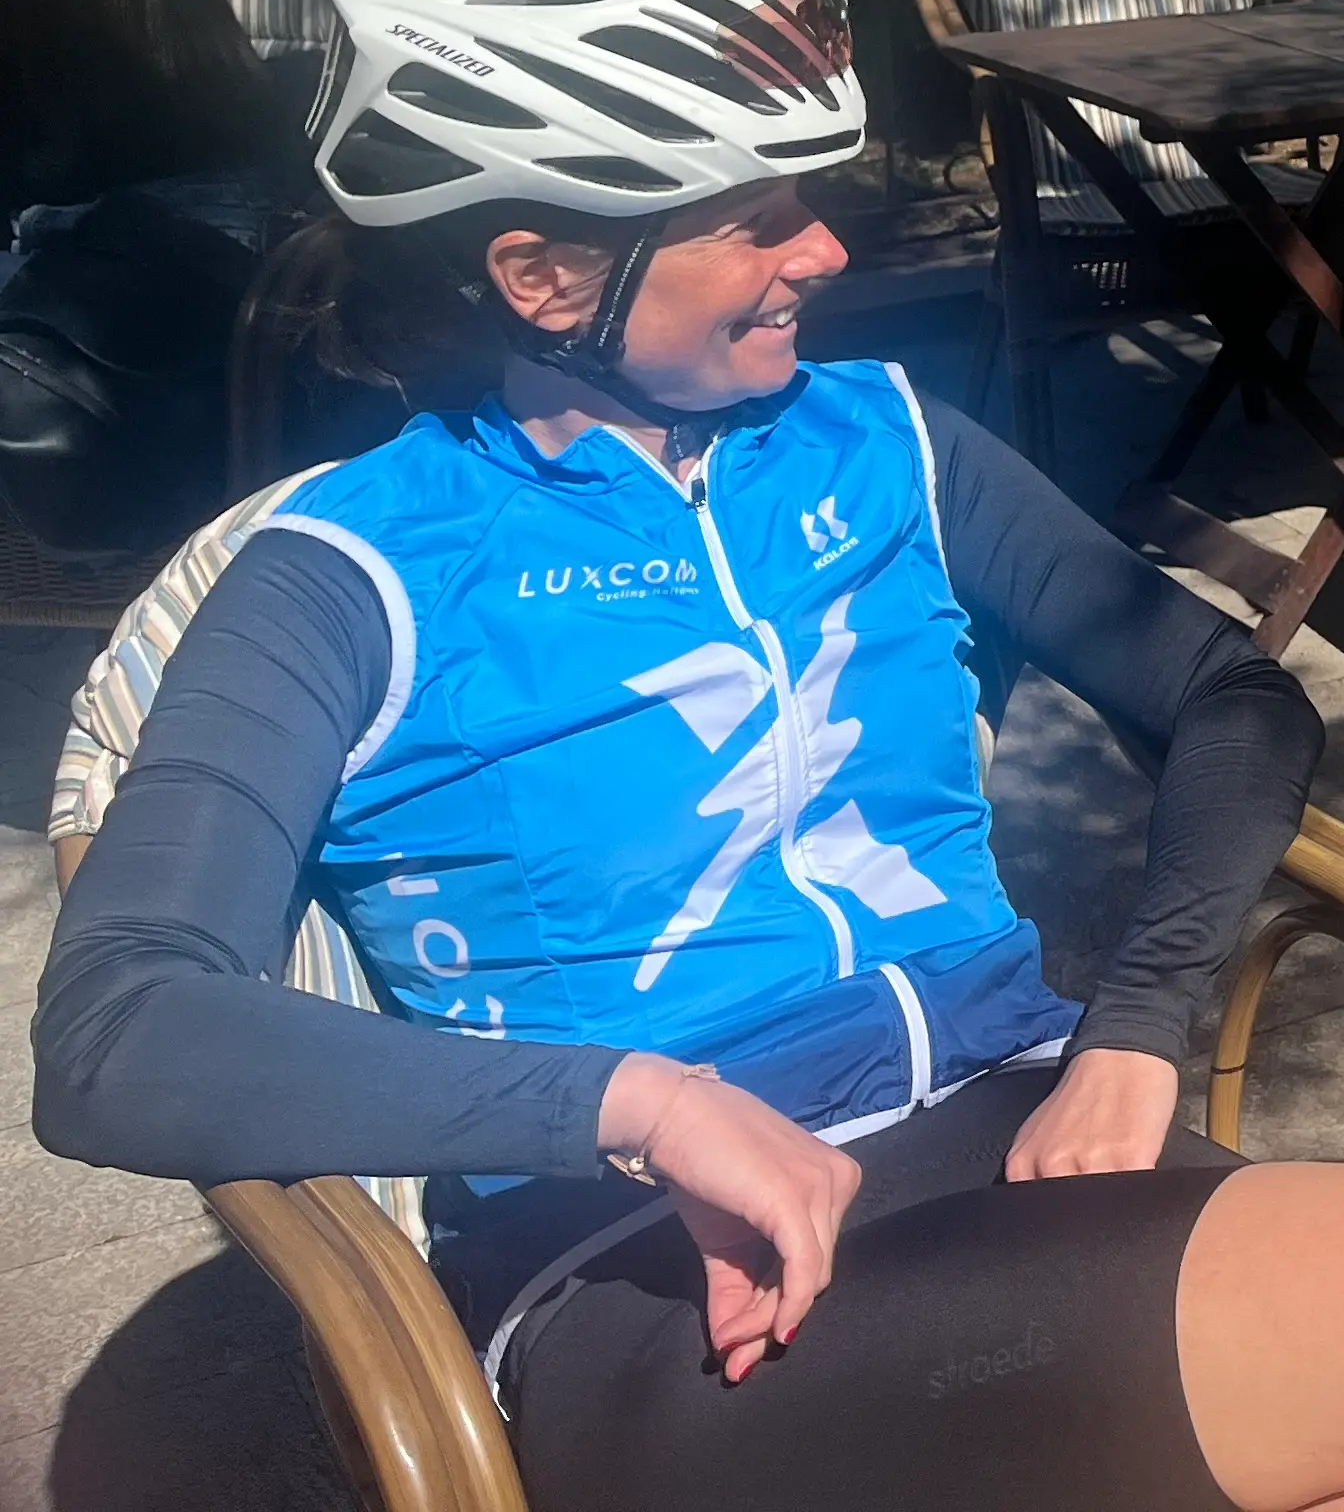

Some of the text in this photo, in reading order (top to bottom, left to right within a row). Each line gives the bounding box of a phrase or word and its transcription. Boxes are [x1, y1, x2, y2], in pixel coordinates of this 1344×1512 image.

[385, 24, 495, 76] SPECIALIZED
[518, 558, 698, 598] LUXCOM
[596, 589, 647, 602] Cycling
